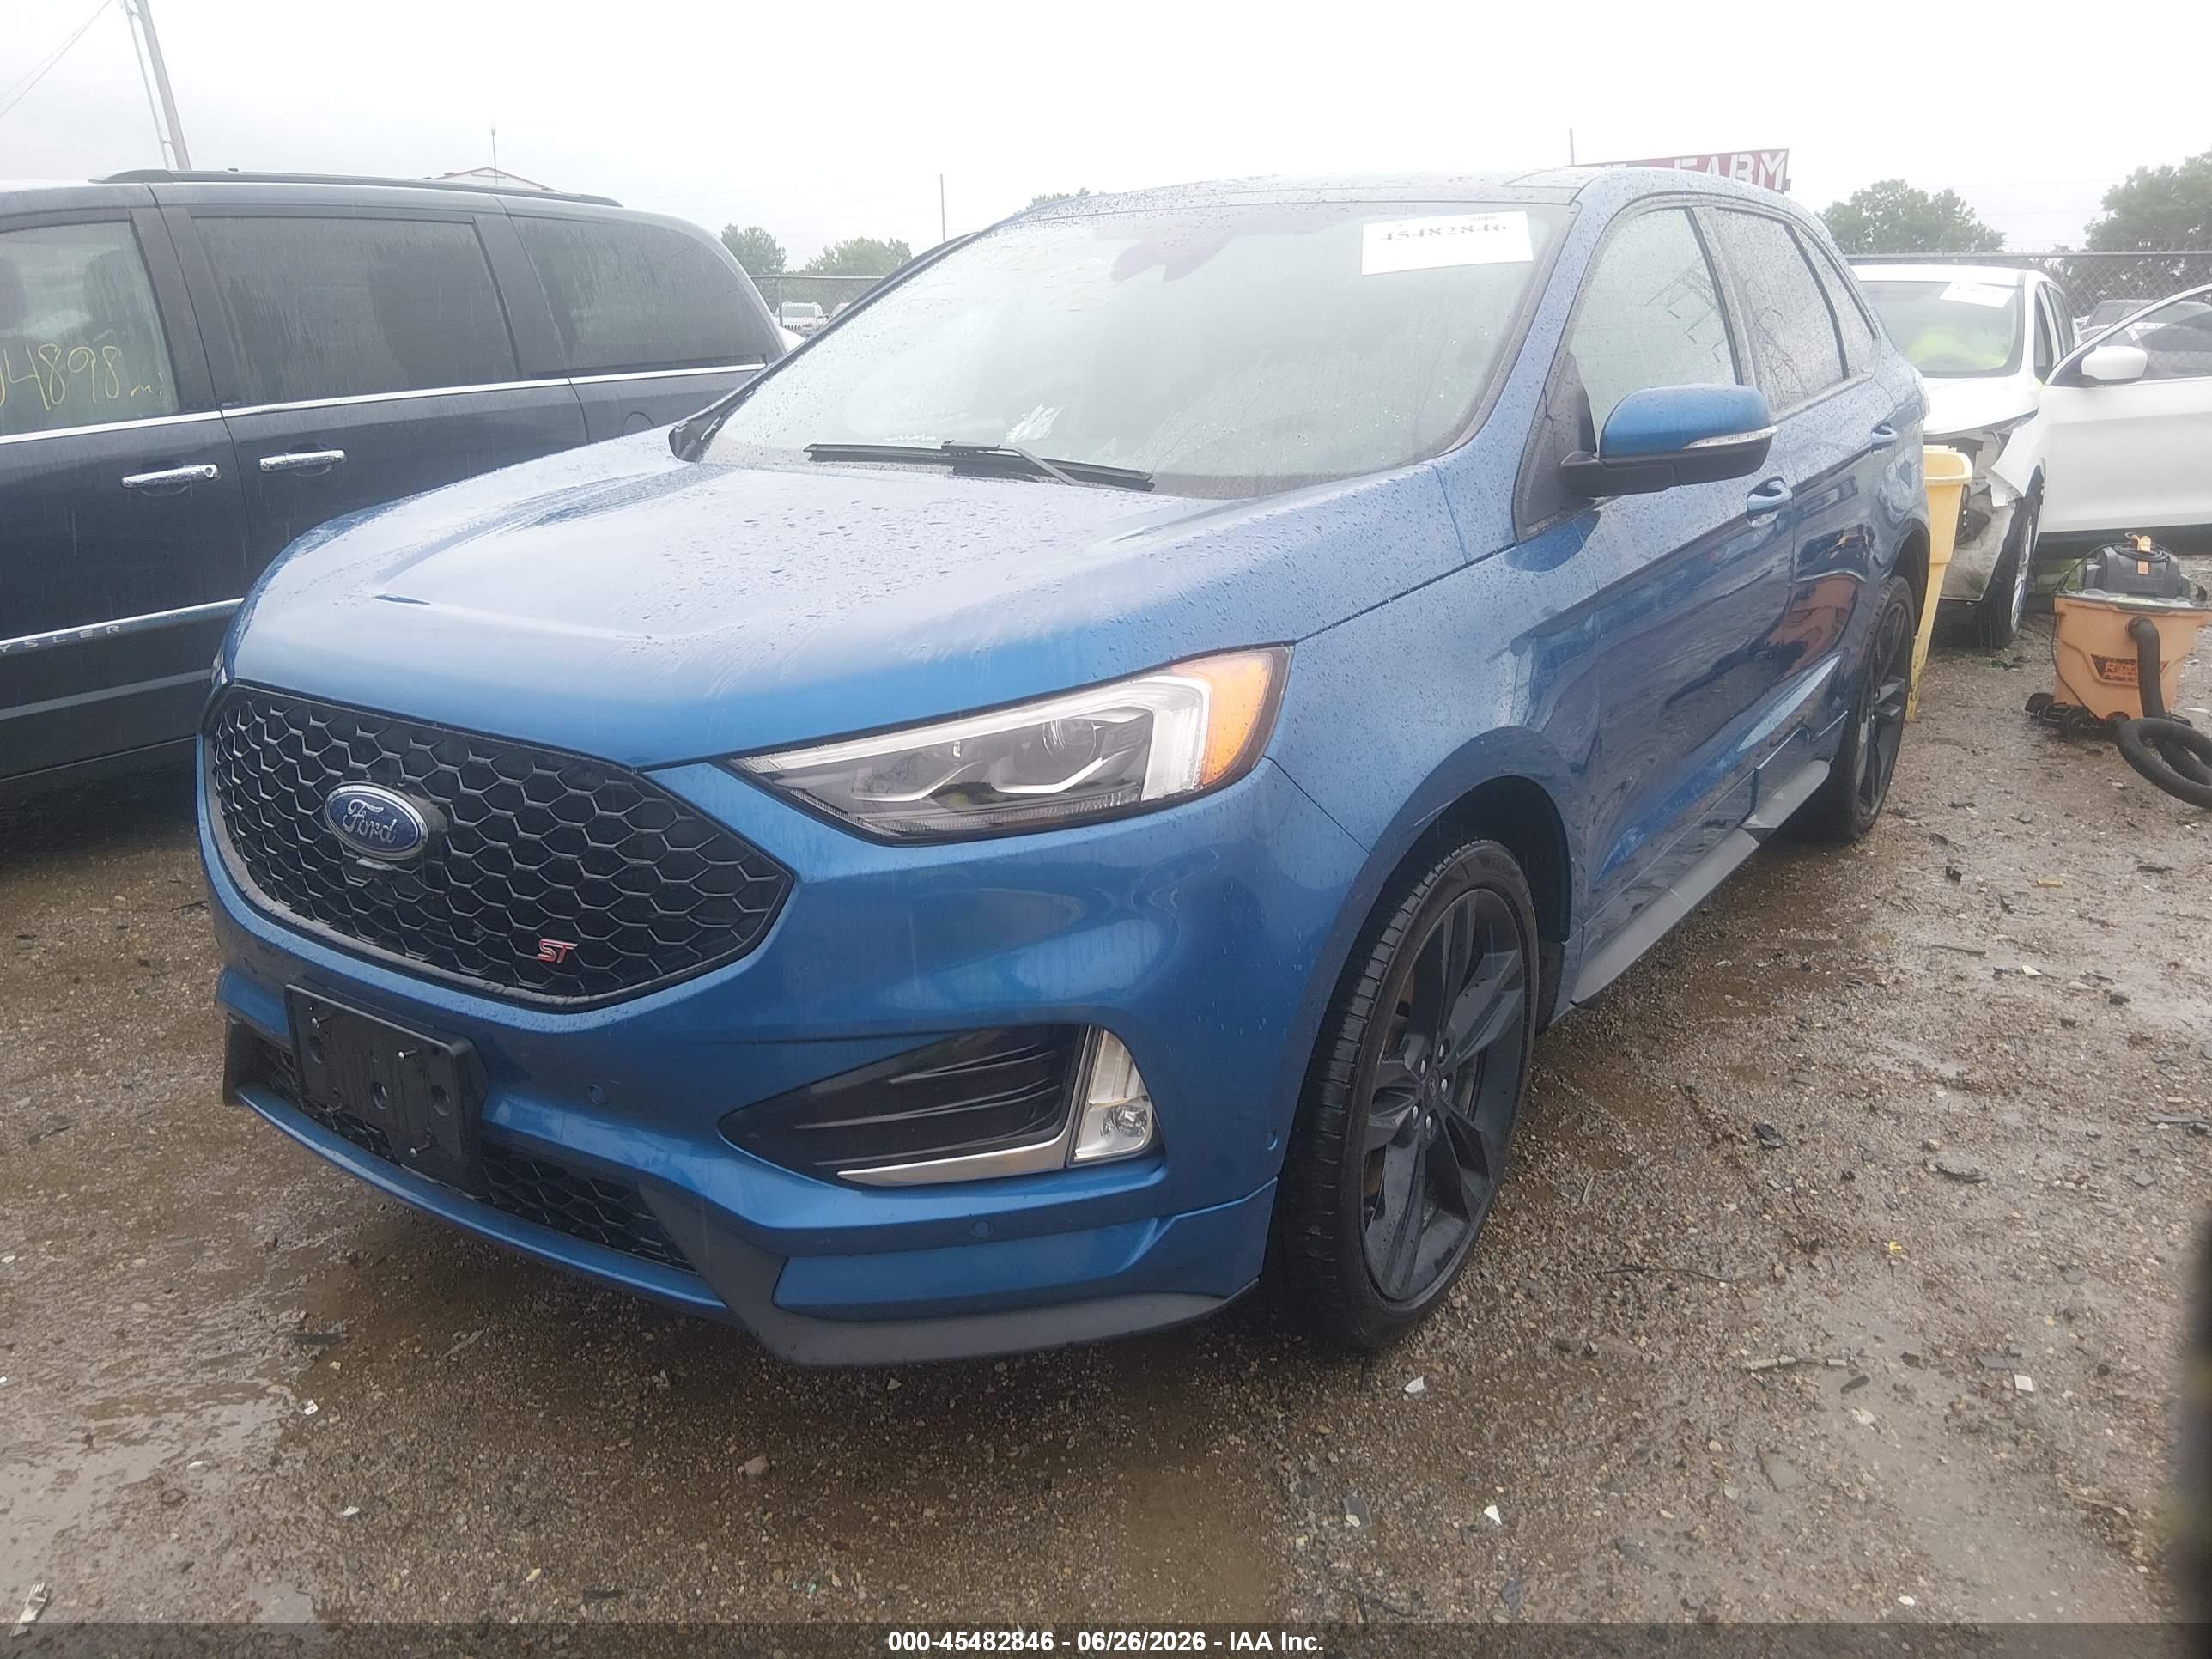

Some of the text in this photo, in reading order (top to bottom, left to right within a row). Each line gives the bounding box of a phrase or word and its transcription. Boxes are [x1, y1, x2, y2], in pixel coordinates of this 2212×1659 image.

[1674, 152, 1785, 190] ARM
[0, 343, 121, 410] 4898
[343, 798, 399, 845] Ford
[537, 939, 578, 963] ST
